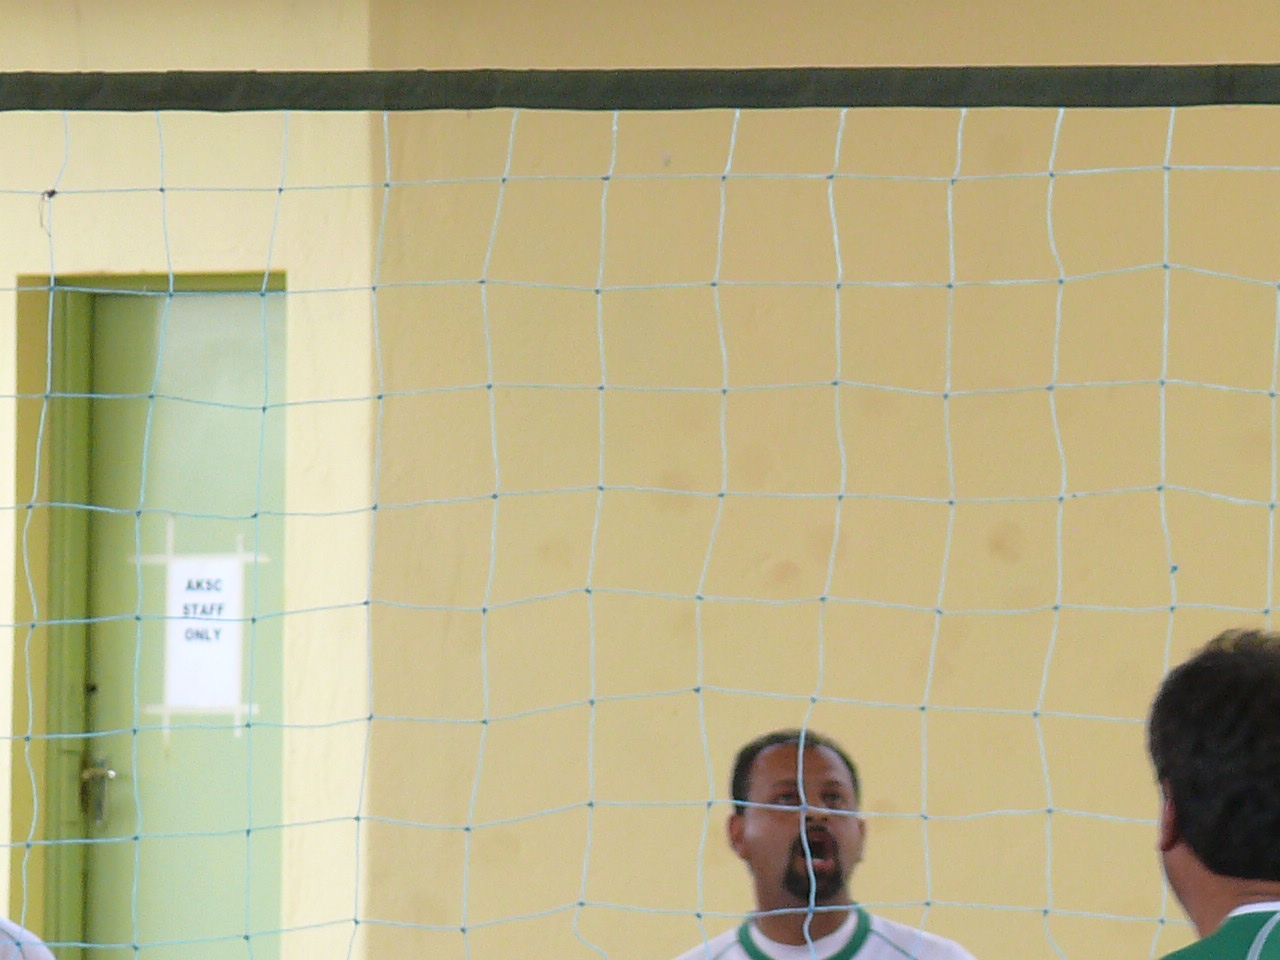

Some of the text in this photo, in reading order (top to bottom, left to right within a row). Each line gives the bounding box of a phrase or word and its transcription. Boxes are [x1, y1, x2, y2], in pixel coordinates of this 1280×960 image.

[186, 578, 223, 592] AKSC
[183, 603, 225, 616] STAFF
[184, 628, 222, 641] ONLY
